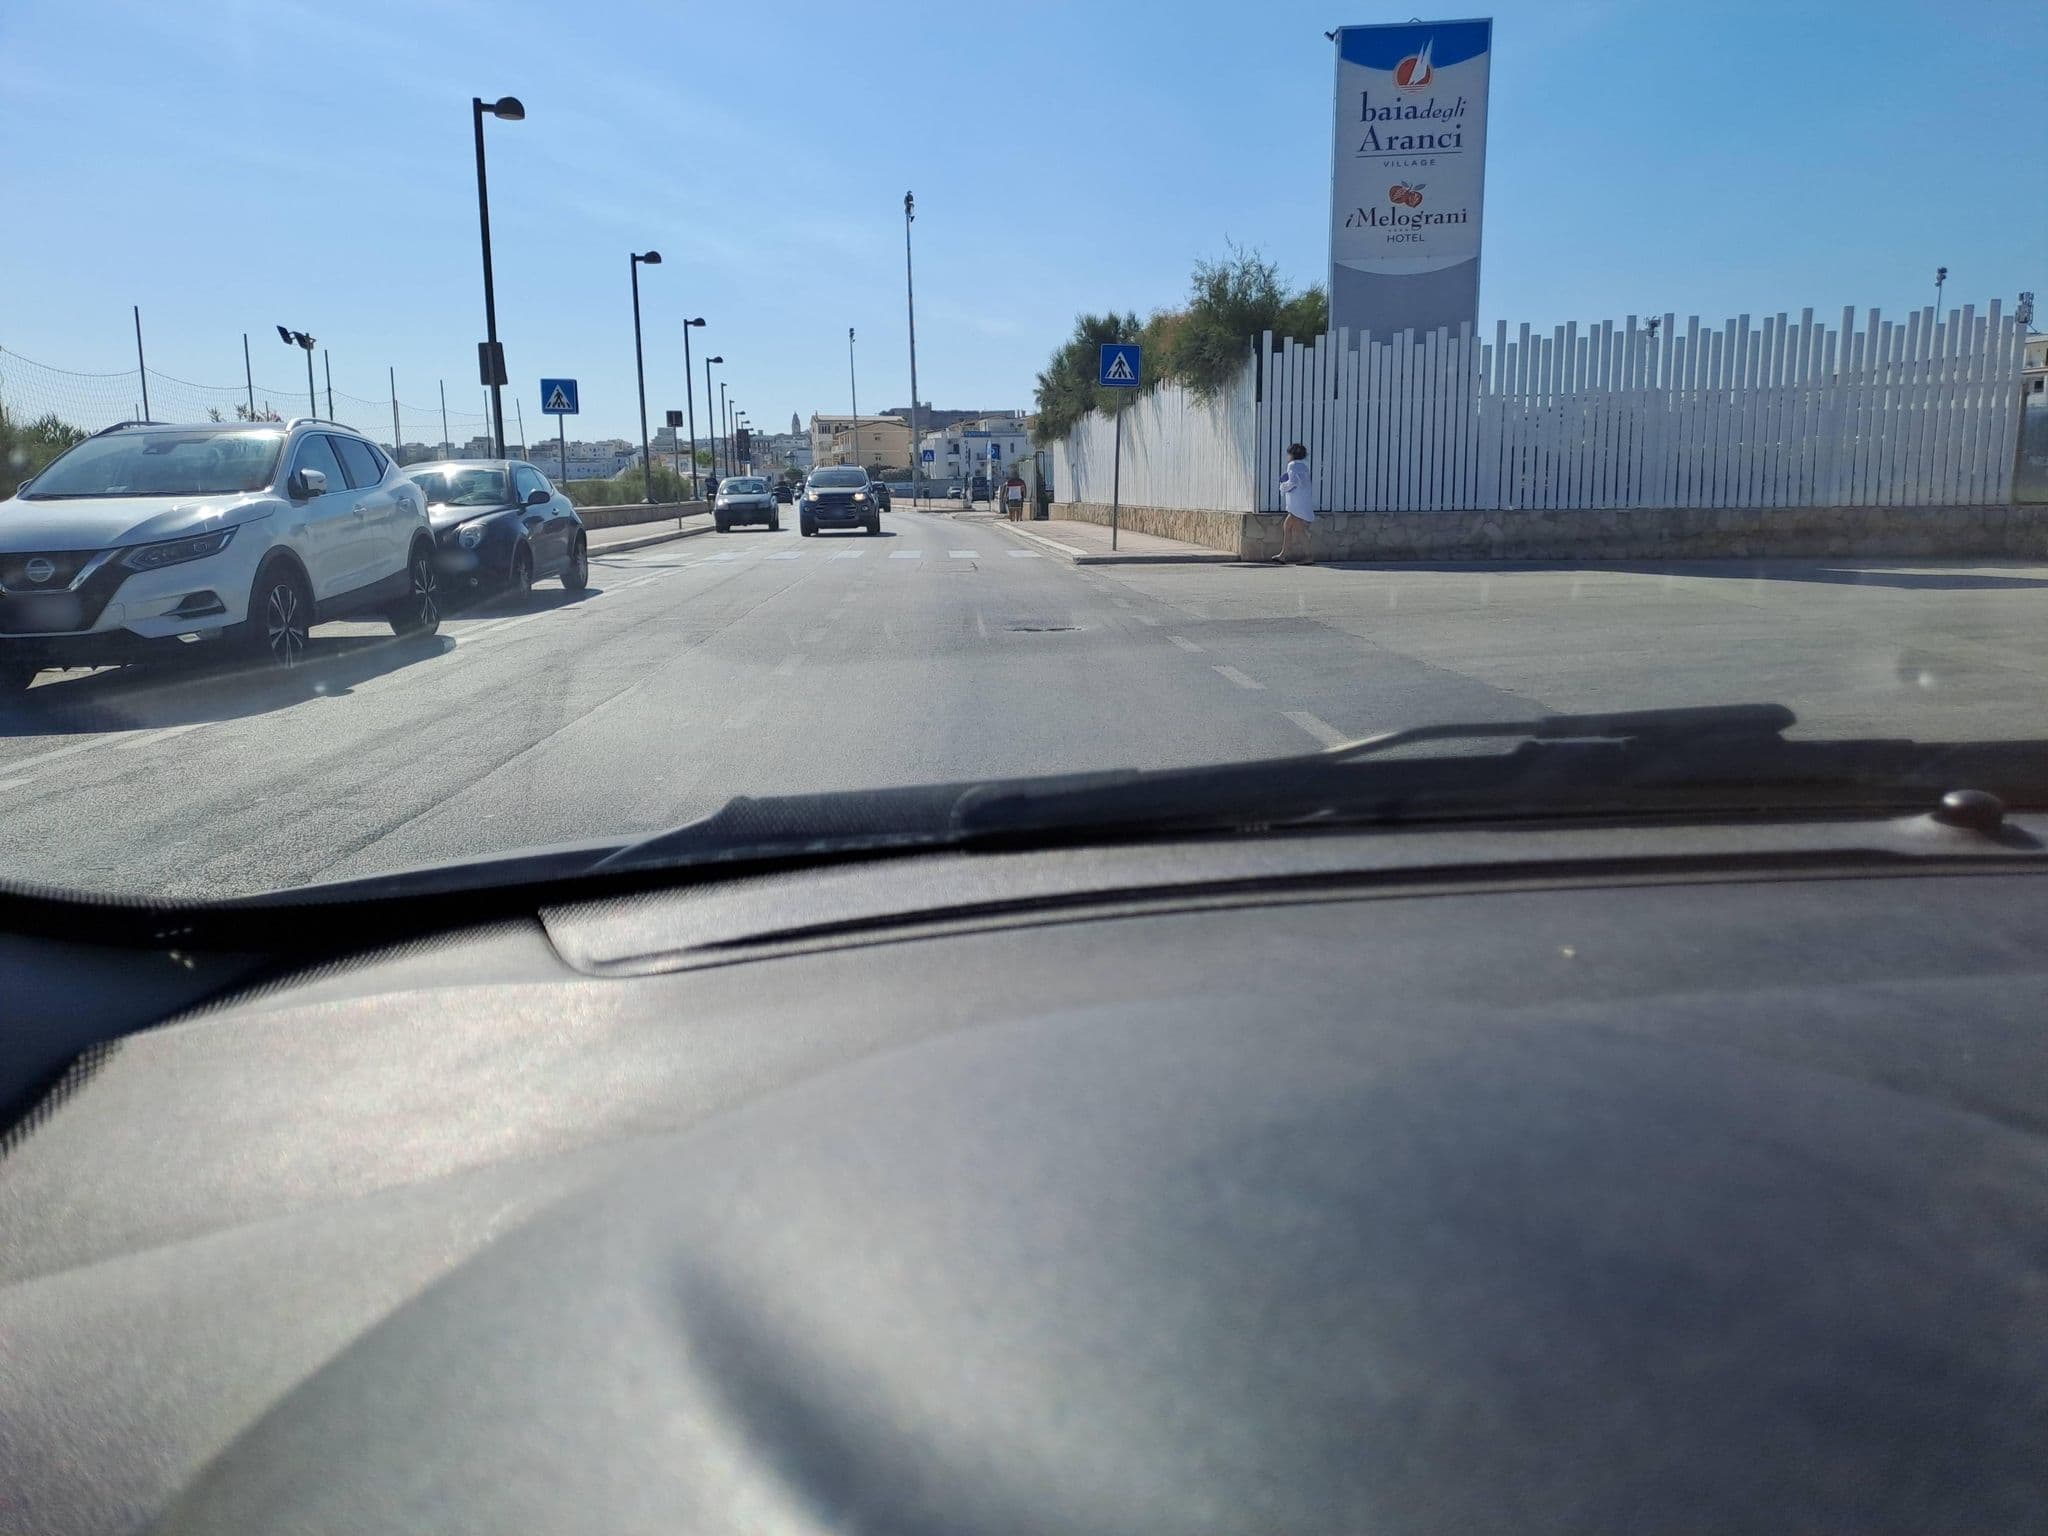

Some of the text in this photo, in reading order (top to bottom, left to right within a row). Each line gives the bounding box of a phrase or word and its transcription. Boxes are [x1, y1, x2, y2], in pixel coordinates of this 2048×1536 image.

[1357, 124, 1464, 152] Aranci
[1383, 159, 1437, 168] VILLAGE
[1387, 234, 1425, 243] HOTEL
